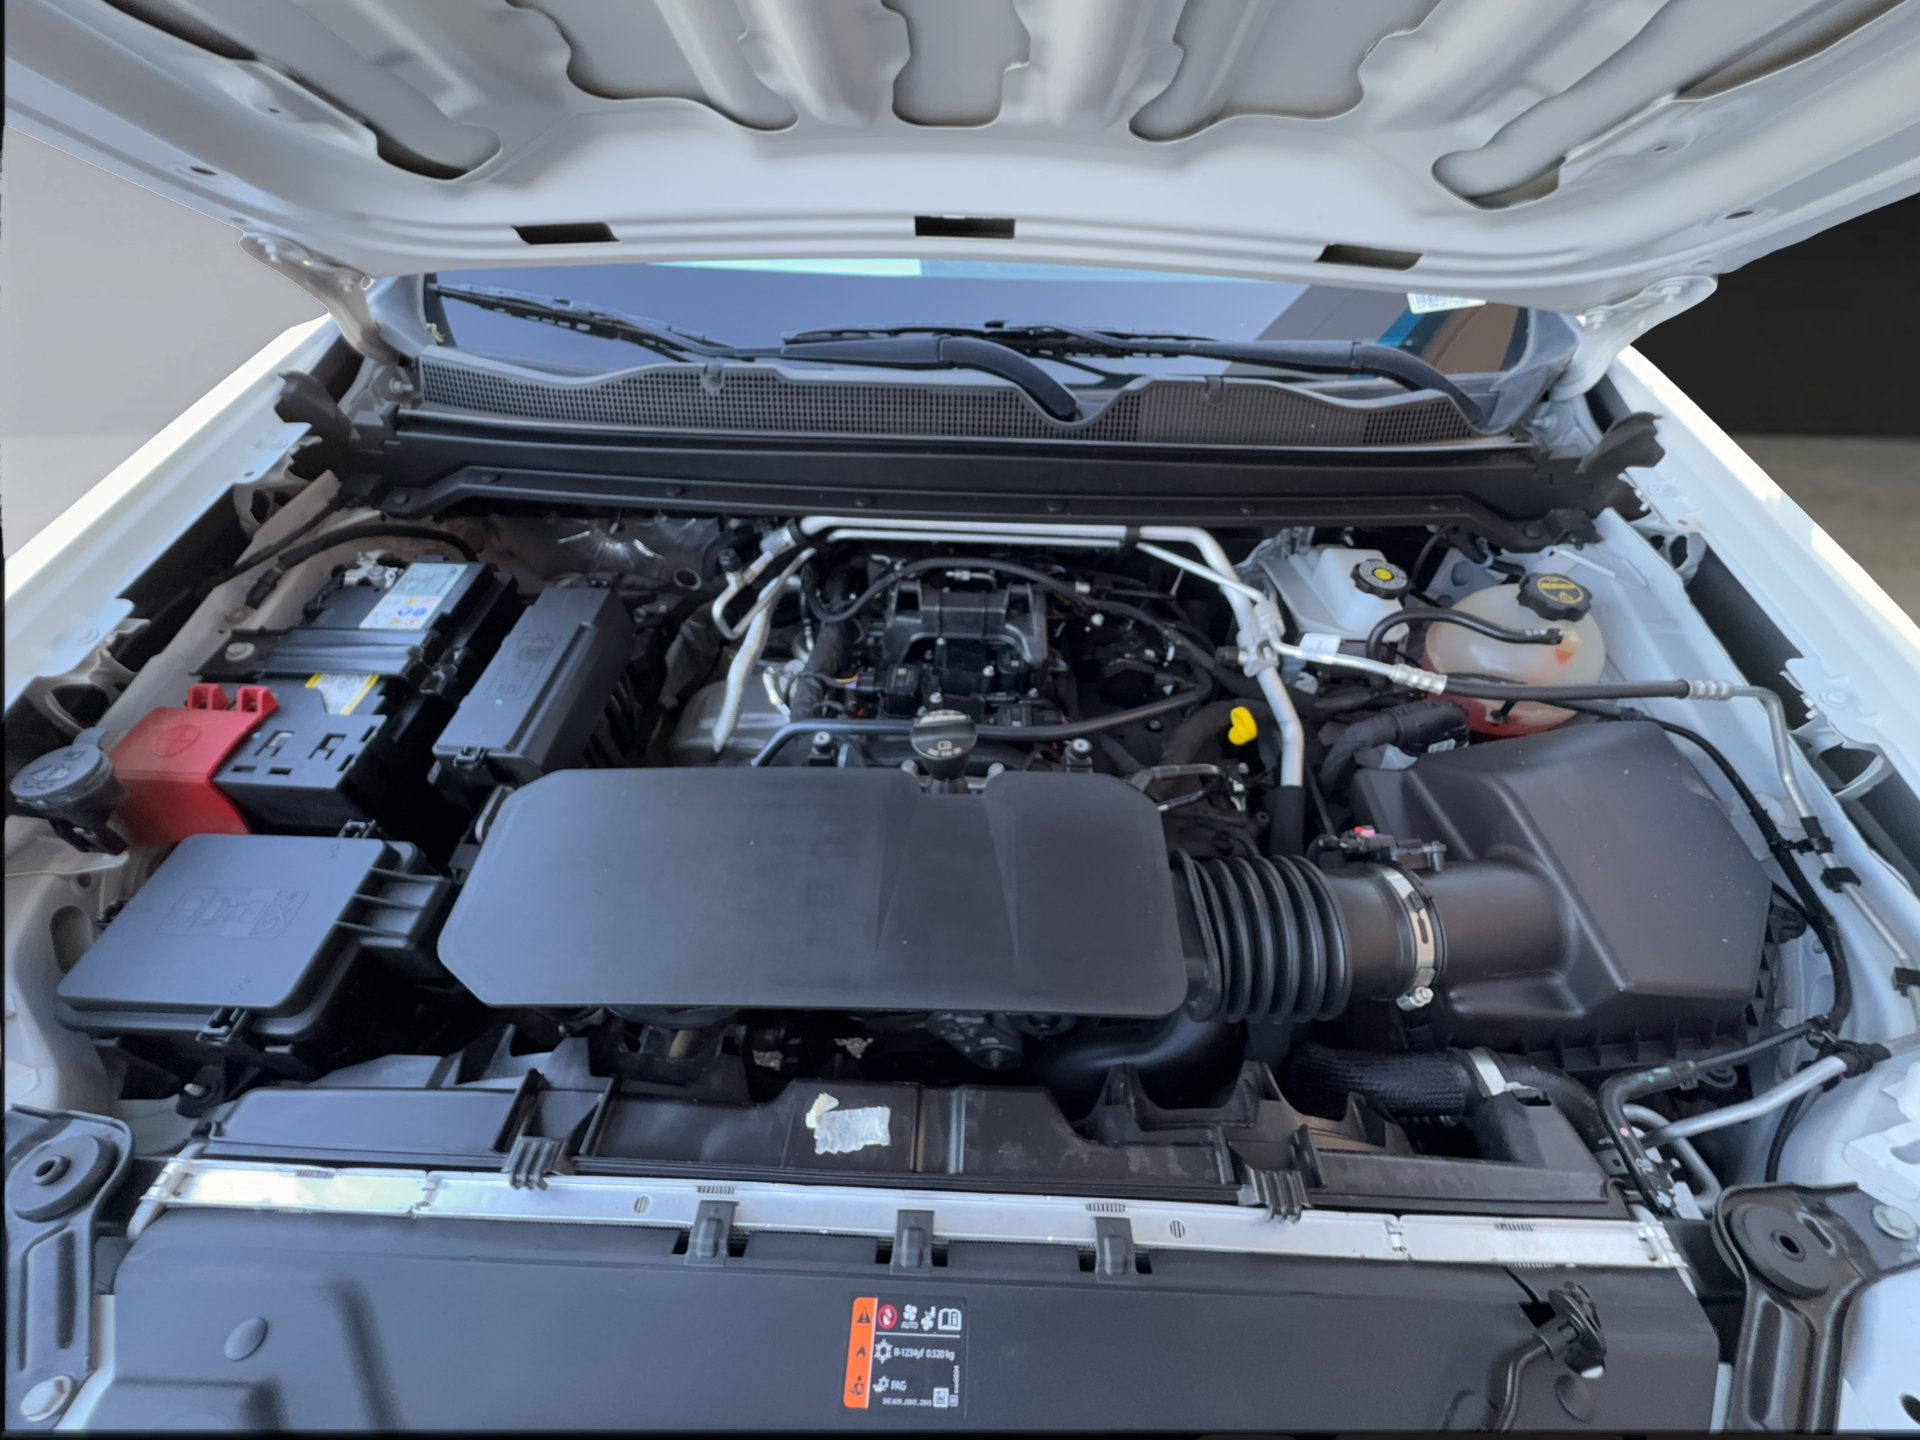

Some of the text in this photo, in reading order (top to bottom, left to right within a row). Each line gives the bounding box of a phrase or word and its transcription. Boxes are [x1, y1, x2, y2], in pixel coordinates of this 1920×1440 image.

[901, 1321, 919, 1330] AUTO
[893, 1347, 925, 1360] R-1234yf
[945, 1349, 956, 1361] kg
[890, 1380, 907, 1391] PAG
